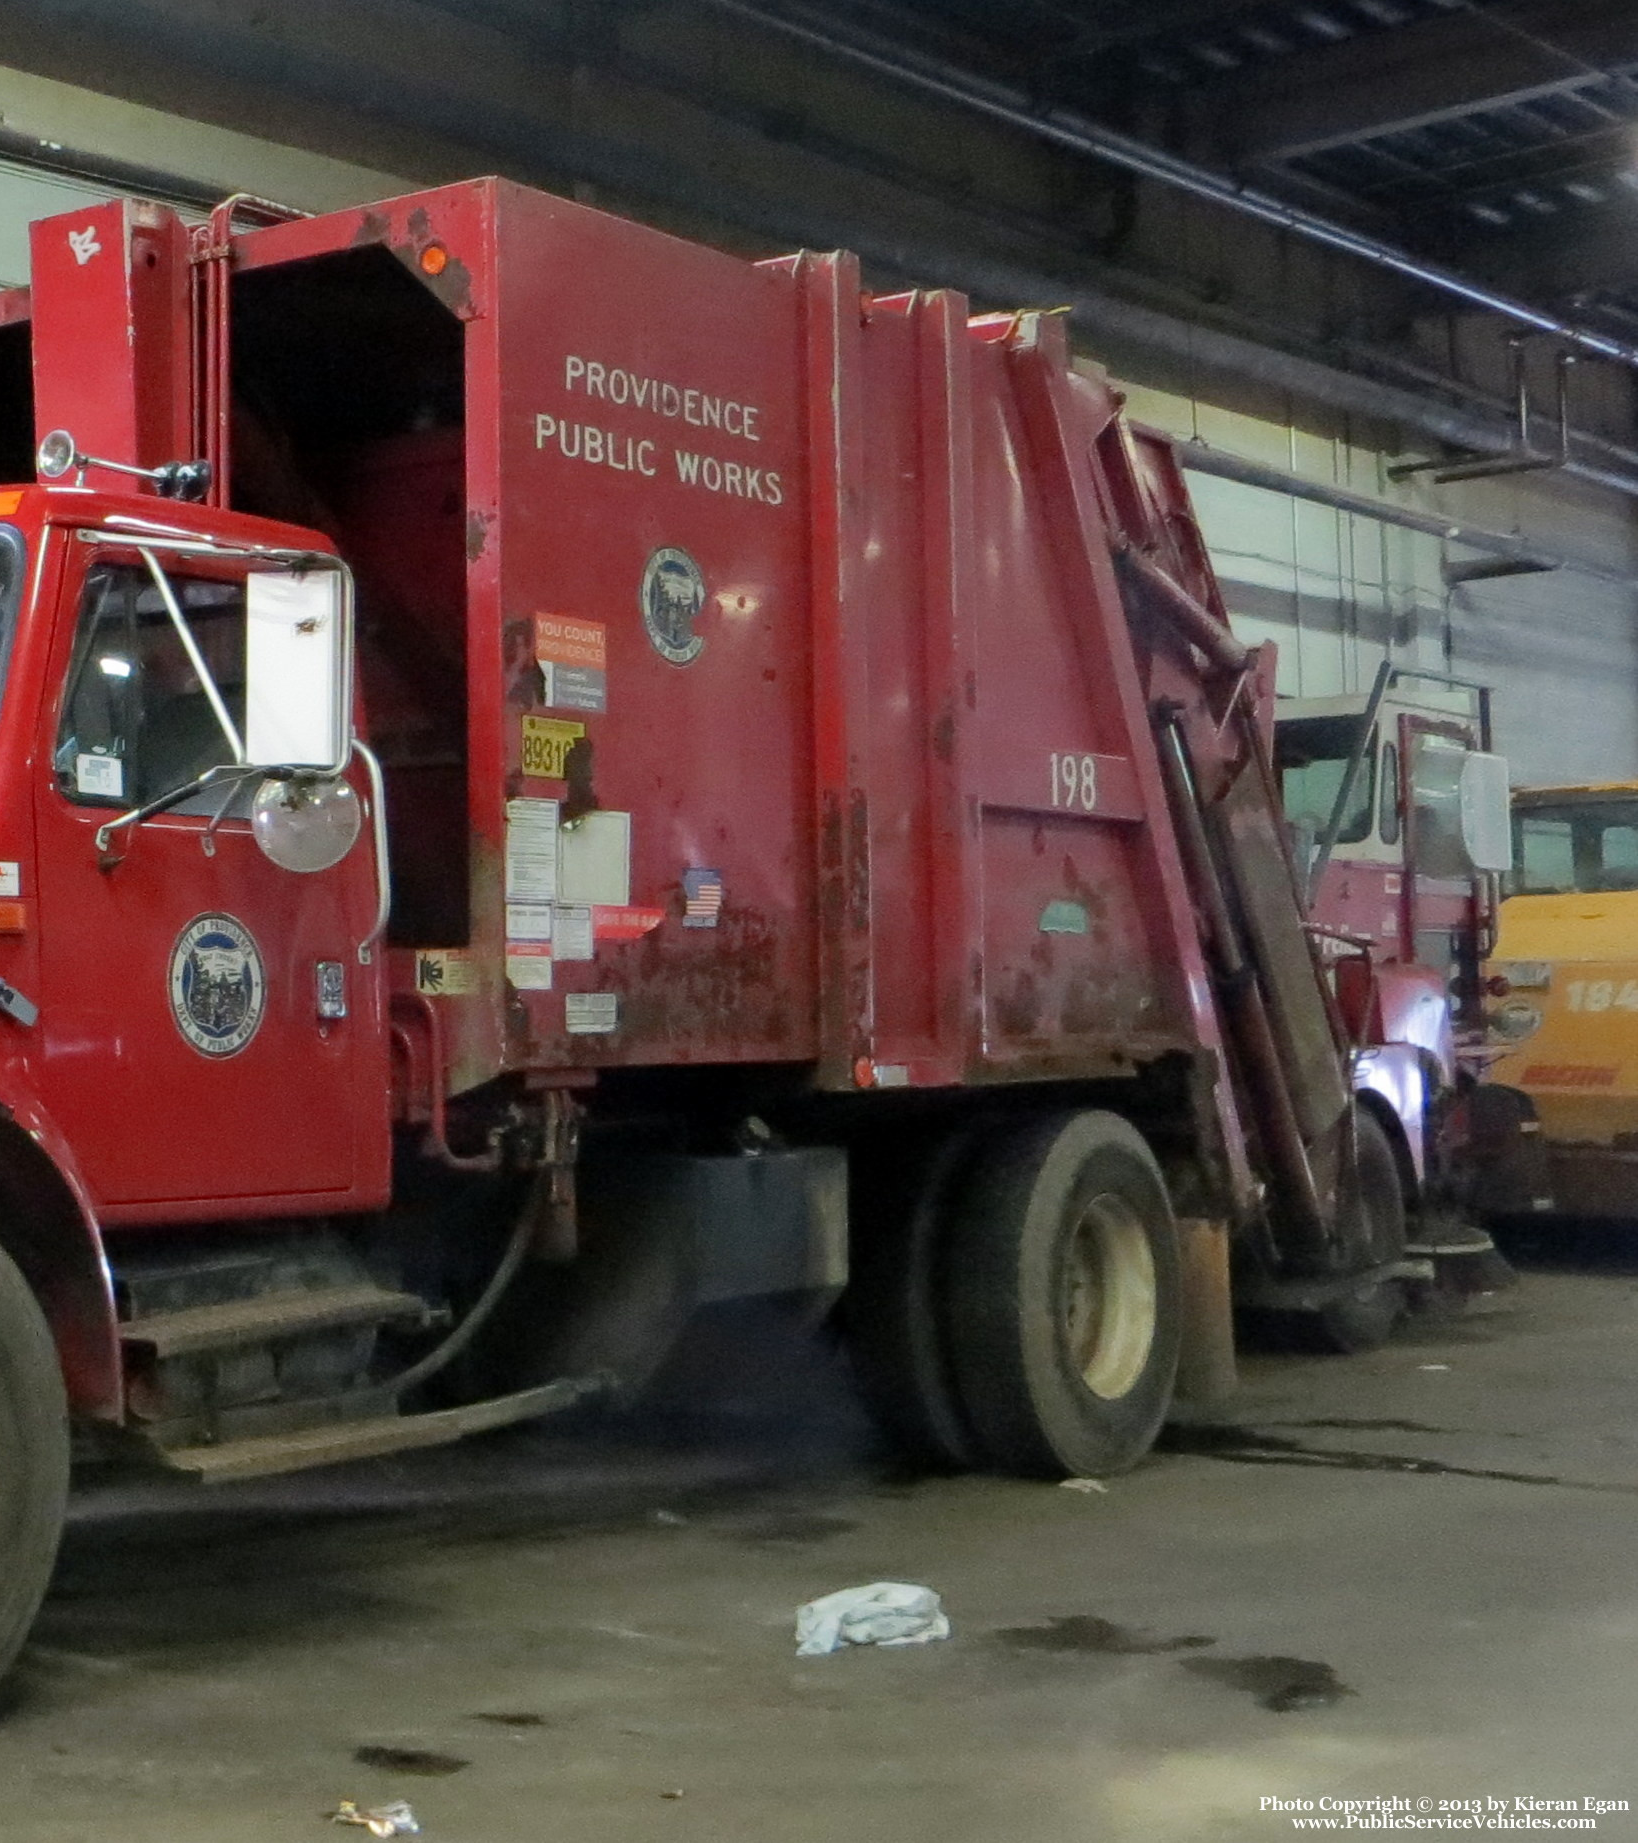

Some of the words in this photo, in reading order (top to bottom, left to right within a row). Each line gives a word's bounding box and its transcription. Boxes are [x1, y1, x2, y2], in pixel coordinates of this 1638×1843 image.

[566, 355, 760, 441] PROVIDENCE
[536, 413, 656, 476] PUBLIC
[675, 449, 783, 505] WORKS
[537, 620, 561, 638] YOU
[1050, 752, 1096, 811] 198
